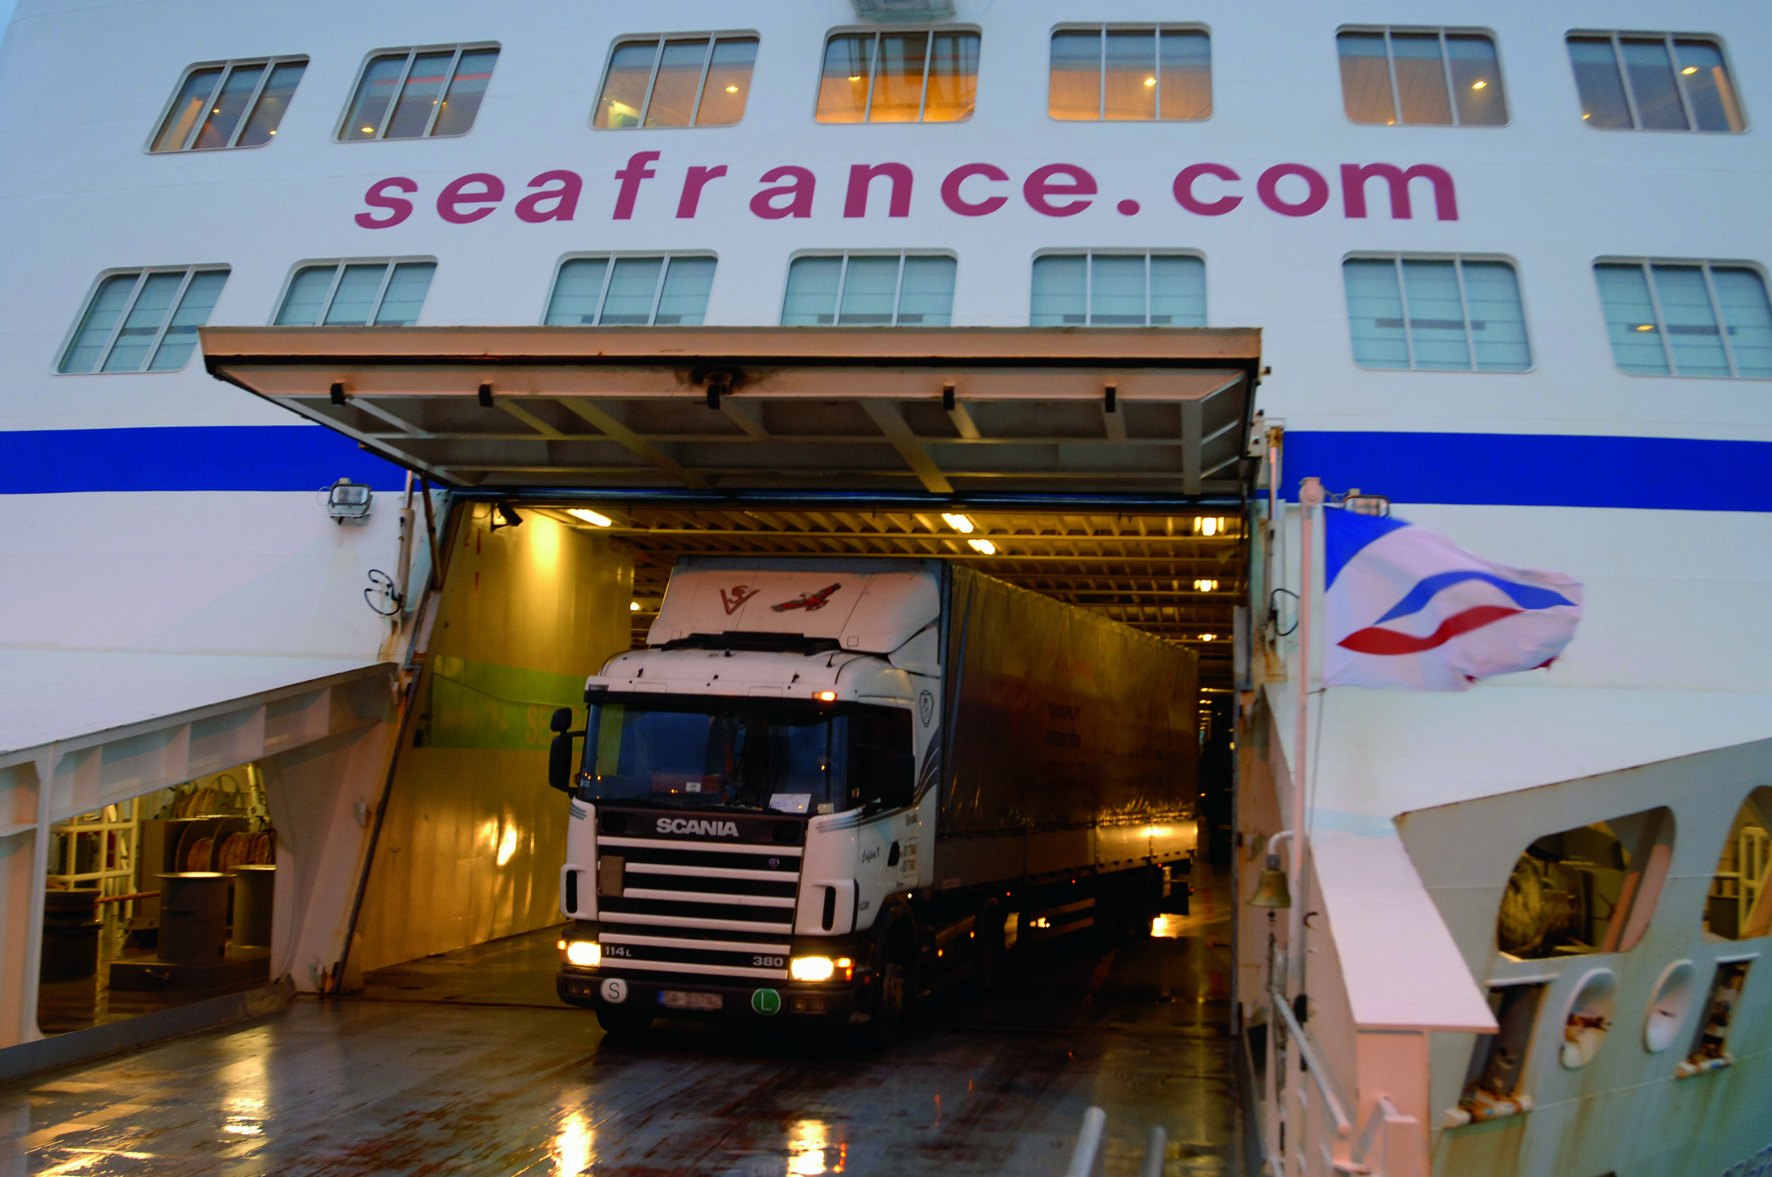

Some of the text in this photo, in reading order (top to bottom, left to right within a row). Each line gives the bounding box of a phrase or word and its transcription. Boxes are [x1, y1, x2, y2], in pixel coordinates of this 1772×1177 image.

[355, 151, 1458, 229] seafrance.com
[656, 817, 739, 837] SCANIA
[752, 956, 784, 967] 380
[608, 981, 620, 1000] S
[761, 991, 773, 1011] L
